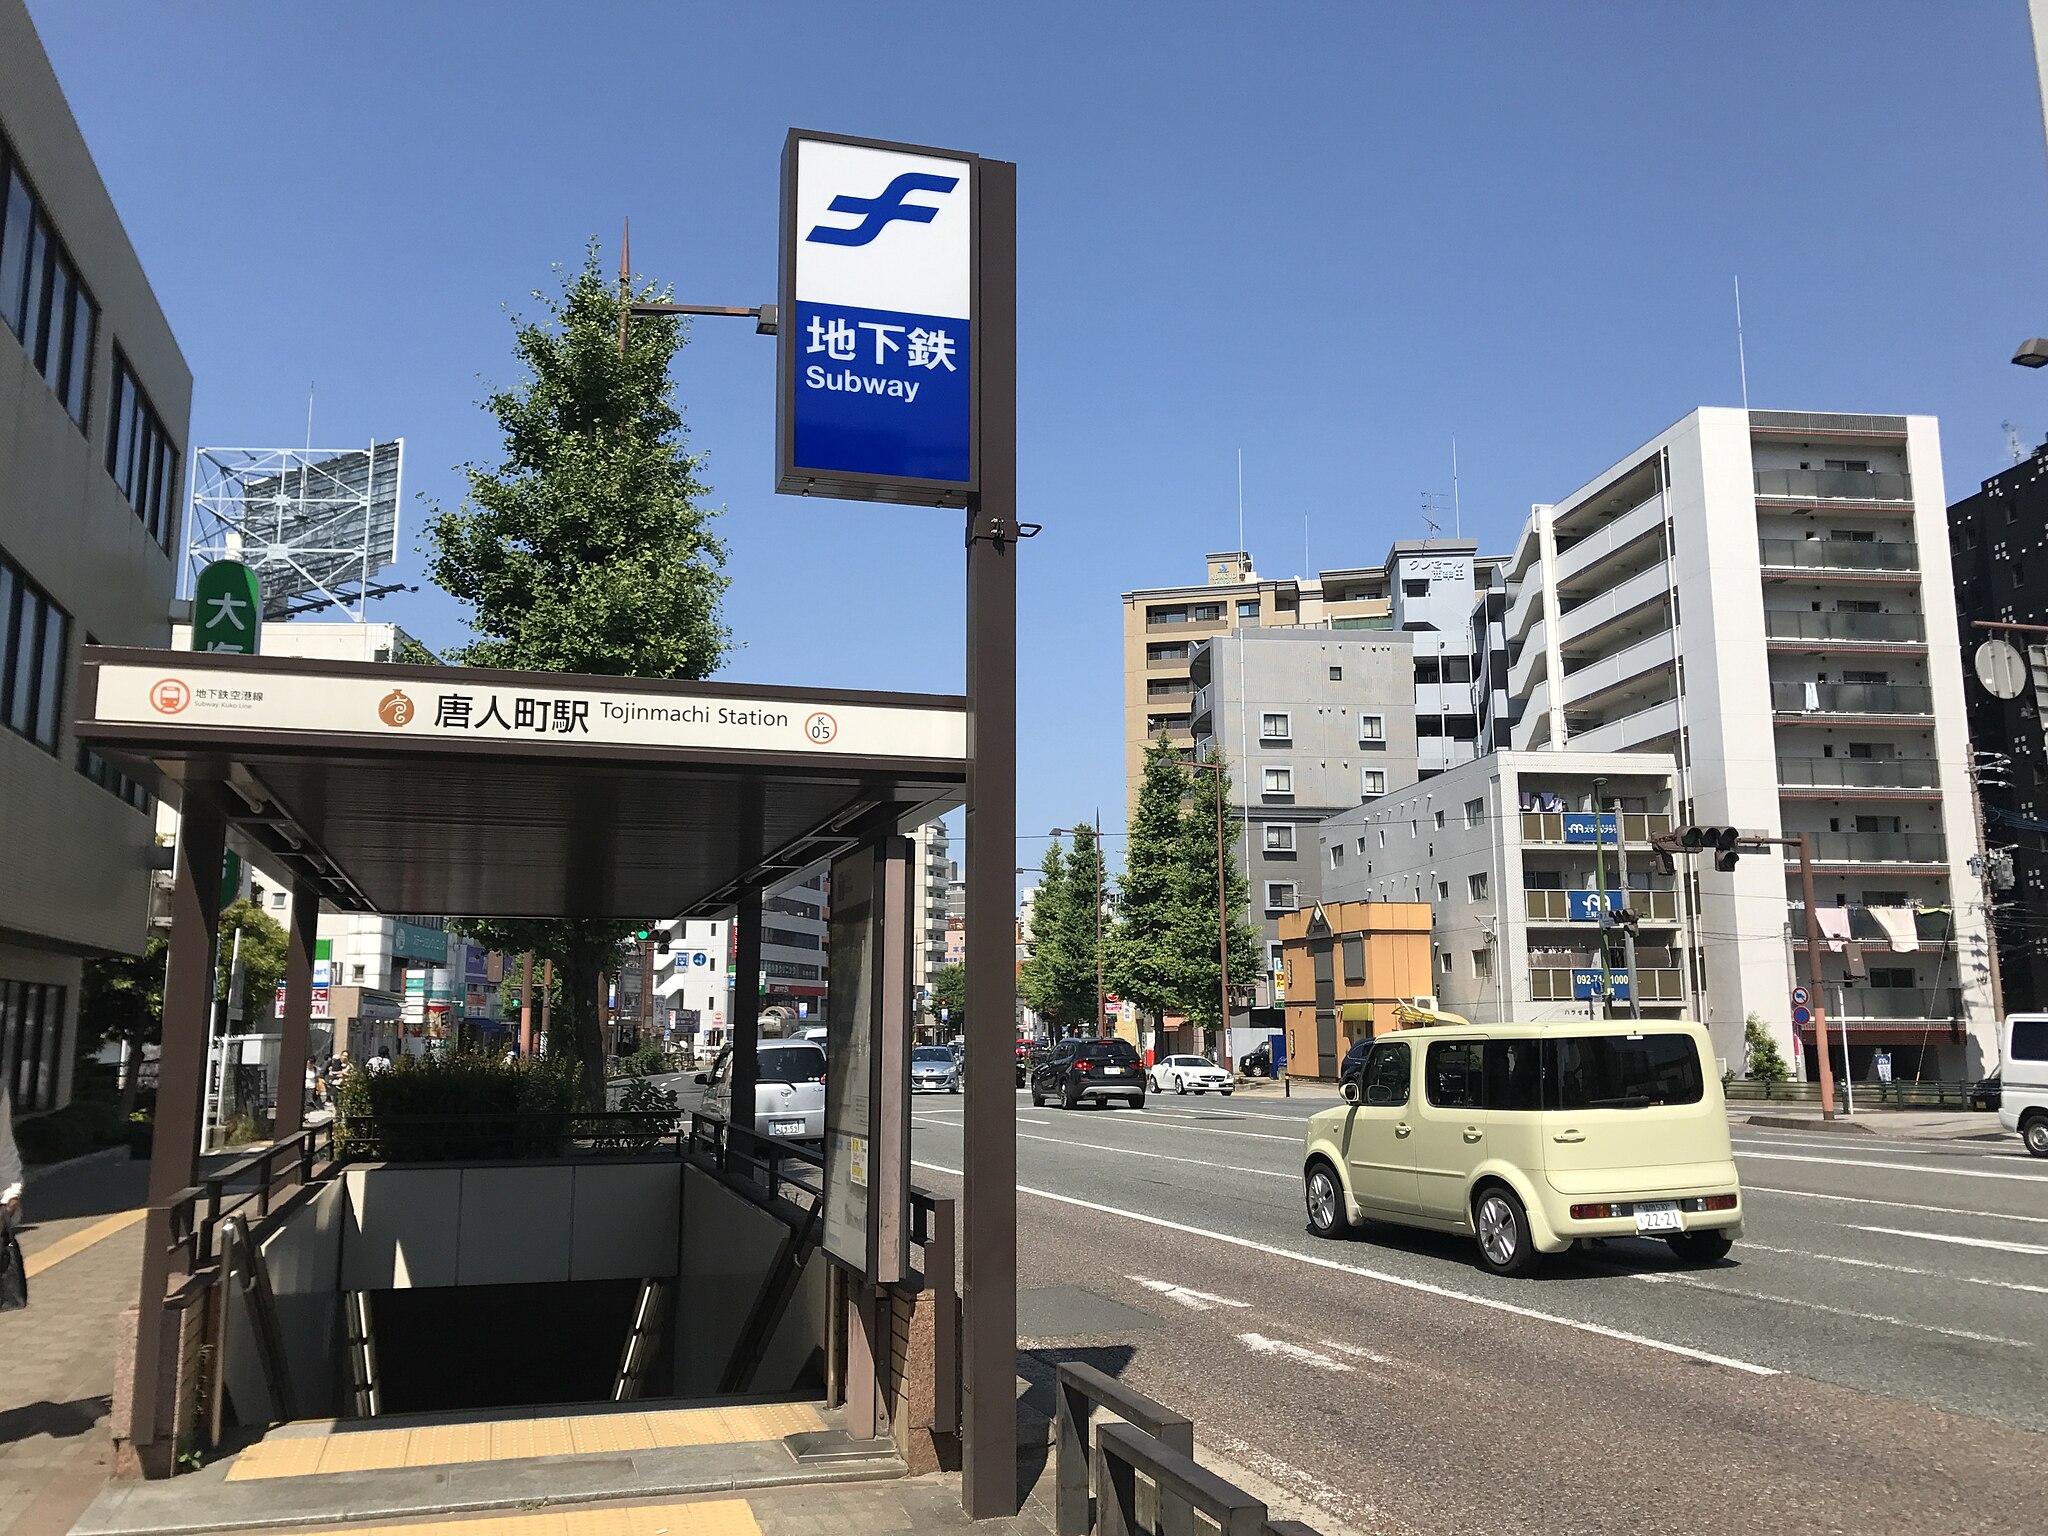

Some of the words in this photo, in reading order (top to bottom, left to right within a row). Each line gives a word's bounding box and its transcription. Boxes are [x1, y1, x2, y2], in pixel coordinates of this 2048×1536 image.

[805, 314, 958, 373] 地下鉄
[805, 365, 920, 403] Subway
[195, 688, 264, 703] 地下鉄空港線
[194, 701, 219, 709] Subway
[434, 692, 590, 735] 唐人町駅
[600, 701, 710, 724] Tojinmachi
[717, 707, 789, 728] Station
[817, 716, 826, 726] K
[811, 725, 831, 740] 05
[1576, 974, 1629, 985] 092-71-1000
[1645, 1211, 1679, 1227] 22-21
